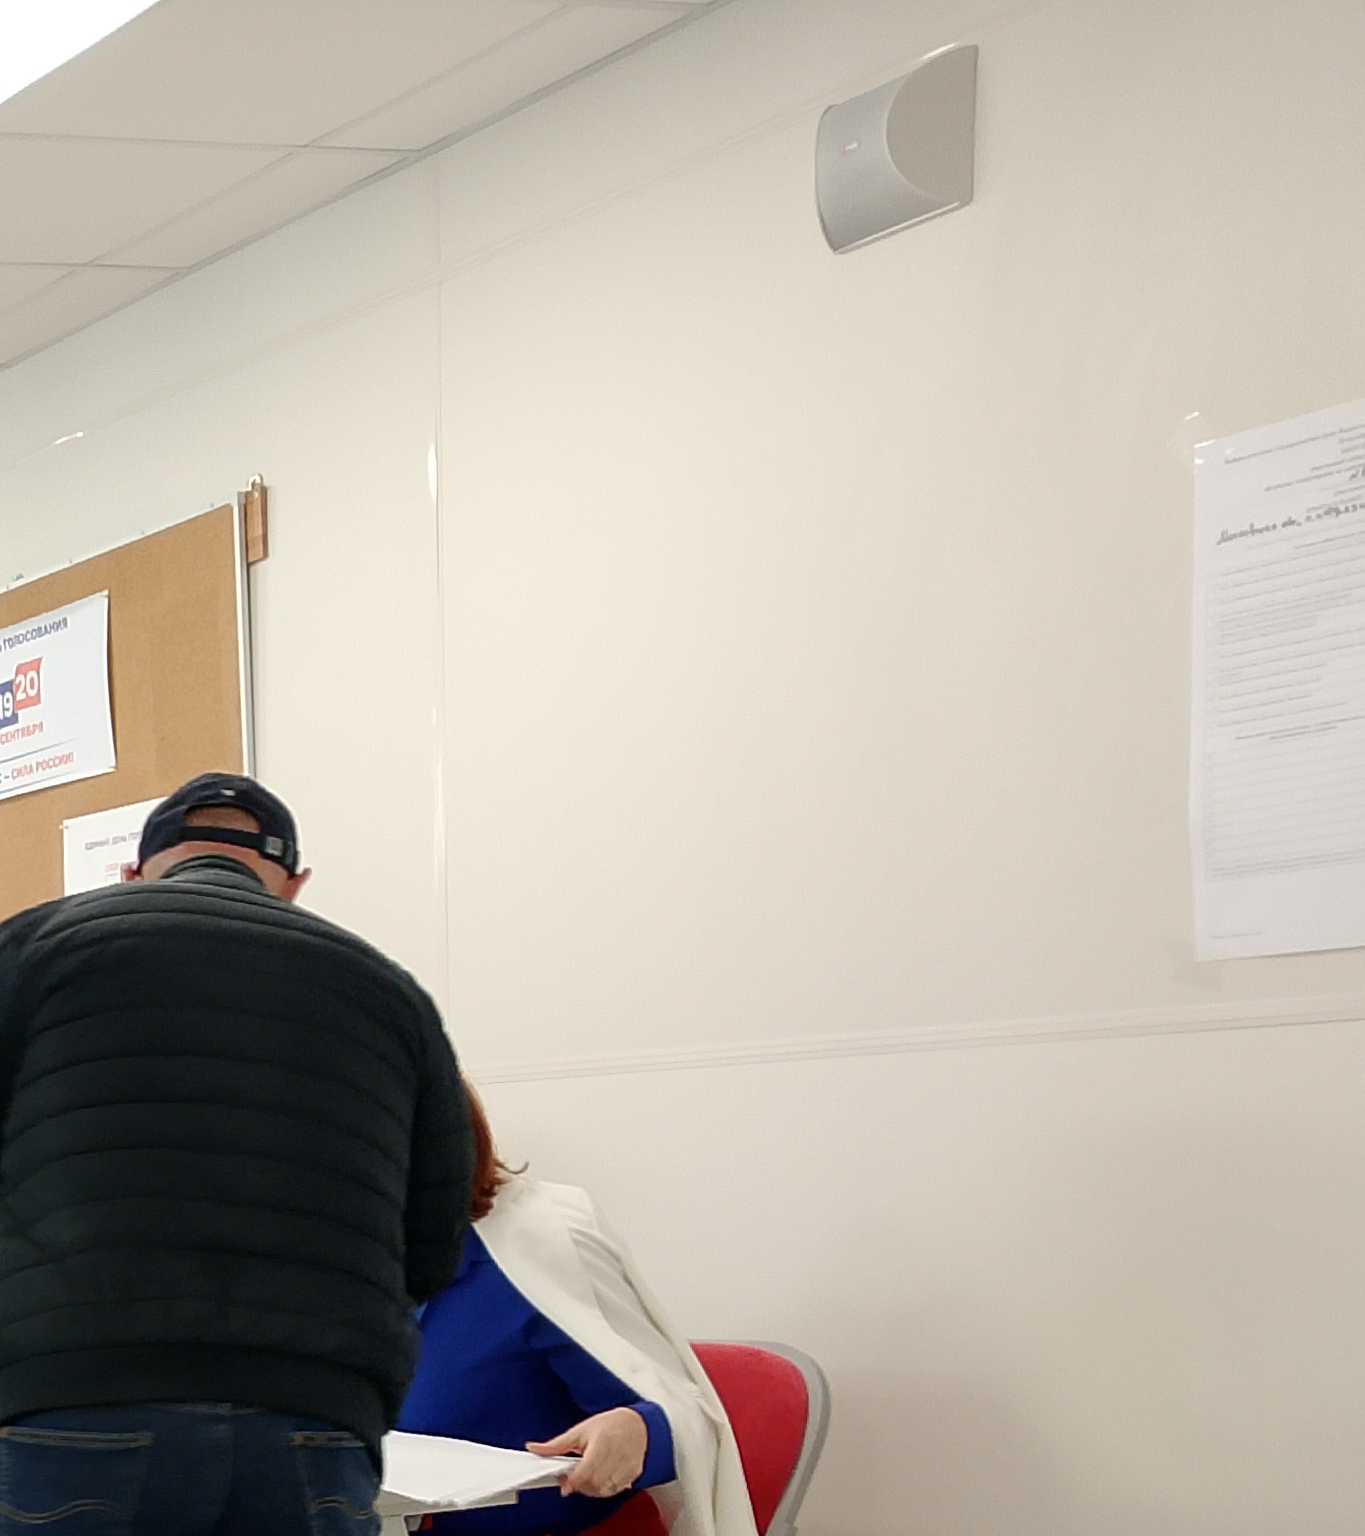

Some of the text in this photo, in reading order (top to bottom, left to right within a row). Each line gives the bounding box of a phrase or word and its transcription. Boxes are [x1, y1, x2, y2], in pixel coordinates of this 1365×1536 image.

[3, 617, 68, 649] ГОЛОСОВАНИЯ
[15, 670, 39, 702] 20
[0, 721, 44, 745] СЕНТЯБРЯ
[11, 764, 35, 780] СИЛА
